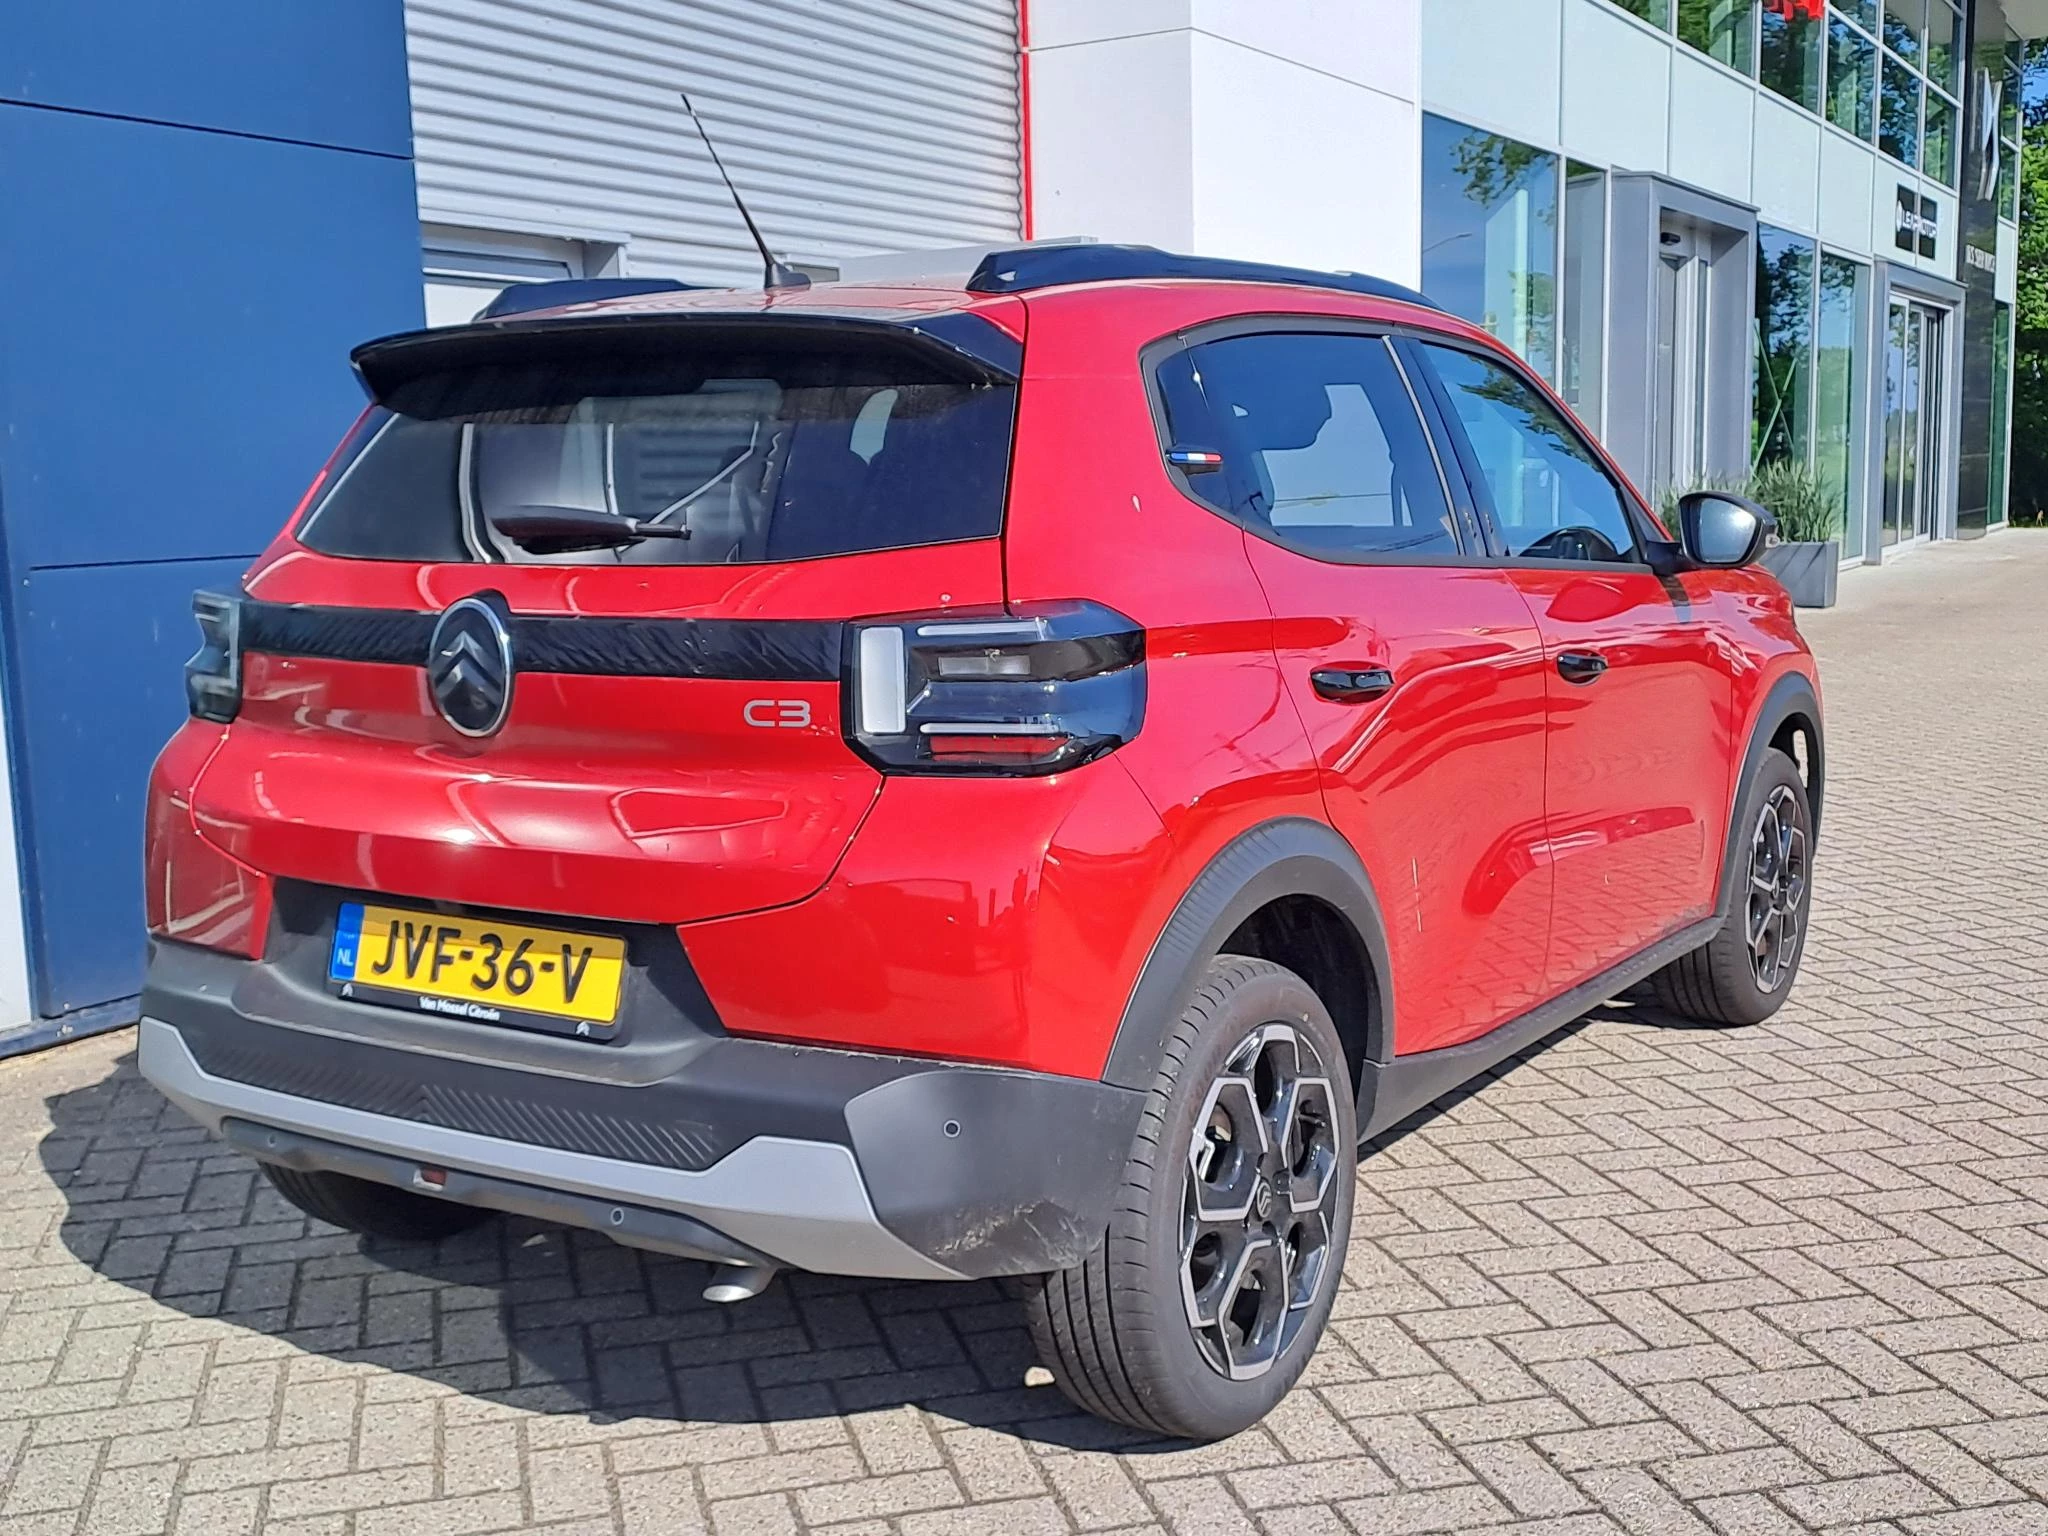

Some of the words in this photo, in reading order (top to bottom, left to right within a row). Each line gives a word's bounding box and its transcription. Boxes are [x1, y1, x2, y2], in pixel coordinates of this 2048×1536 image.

[743, 699, 811, 727] C3
[337, 948, 354, 967] NL
[372, 920, 593, 1003] JVF-36-V
[420, 996, 436, 1011] Van
[437, 999, 467, 1016] Mossel
[468, 1003, 500, 1020] Citroën
